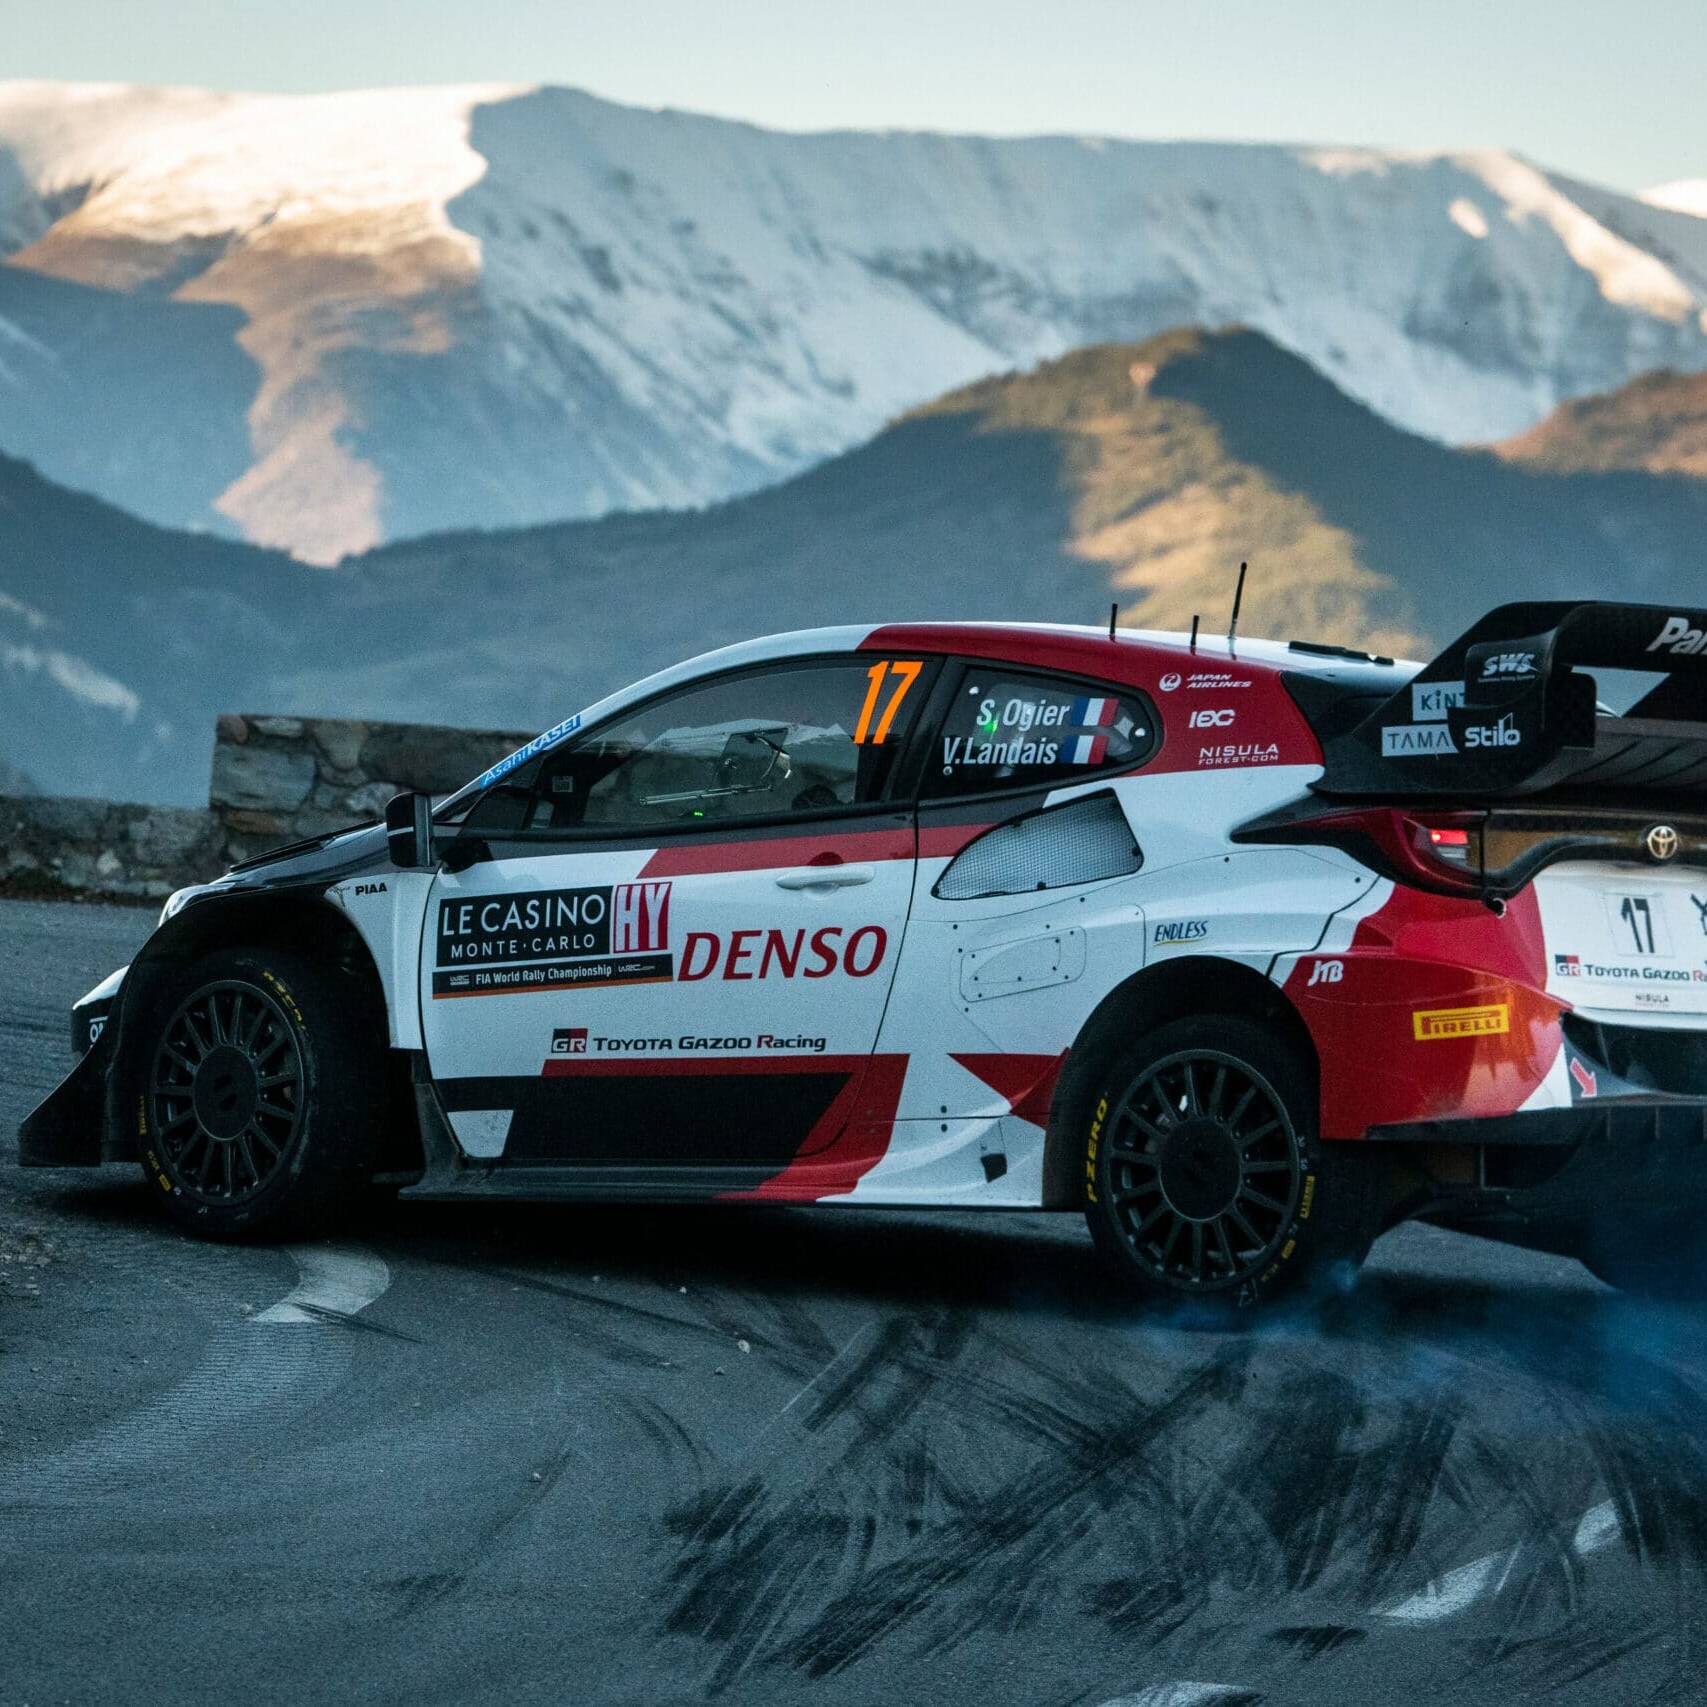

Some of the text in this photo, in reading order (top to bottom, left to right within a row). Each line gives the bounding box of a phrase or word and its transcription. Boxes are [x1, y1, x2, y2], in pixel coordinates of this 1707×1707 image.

[1187, 681, 1252, 689] AIRLINES
[853, 661, 924, 745] 17
[1465, 712, 1520, 747] Stilo
[1200, 743, 1279, 758] NISULA
[355, 882, 388, 896] PIAA
[443, 894, 606, 936] LE CASINO
[614, 884, 671, 952] HY
[1621, 898, 1655, 954] 17
[1154, 920, 1208, 942] ENDLESS
[678, 926, 886, 981] DENSO
[475, 973, 492, 985] FIA
[493, 969, 520, 983] World
[523, 968, 546, 982] Rally
[548, 964, 612, 981] Championship
[1307, 960, 1344, 987] JTB
[1584, 965, 1640, 978] TOYOTA
[1643, 967, 1690, 981] GAZOO
[1422, 1010, 1501, 1035] PIRELLI
[553, 1034, 827, 1053] GR TOYOTA GAZOO Racing
